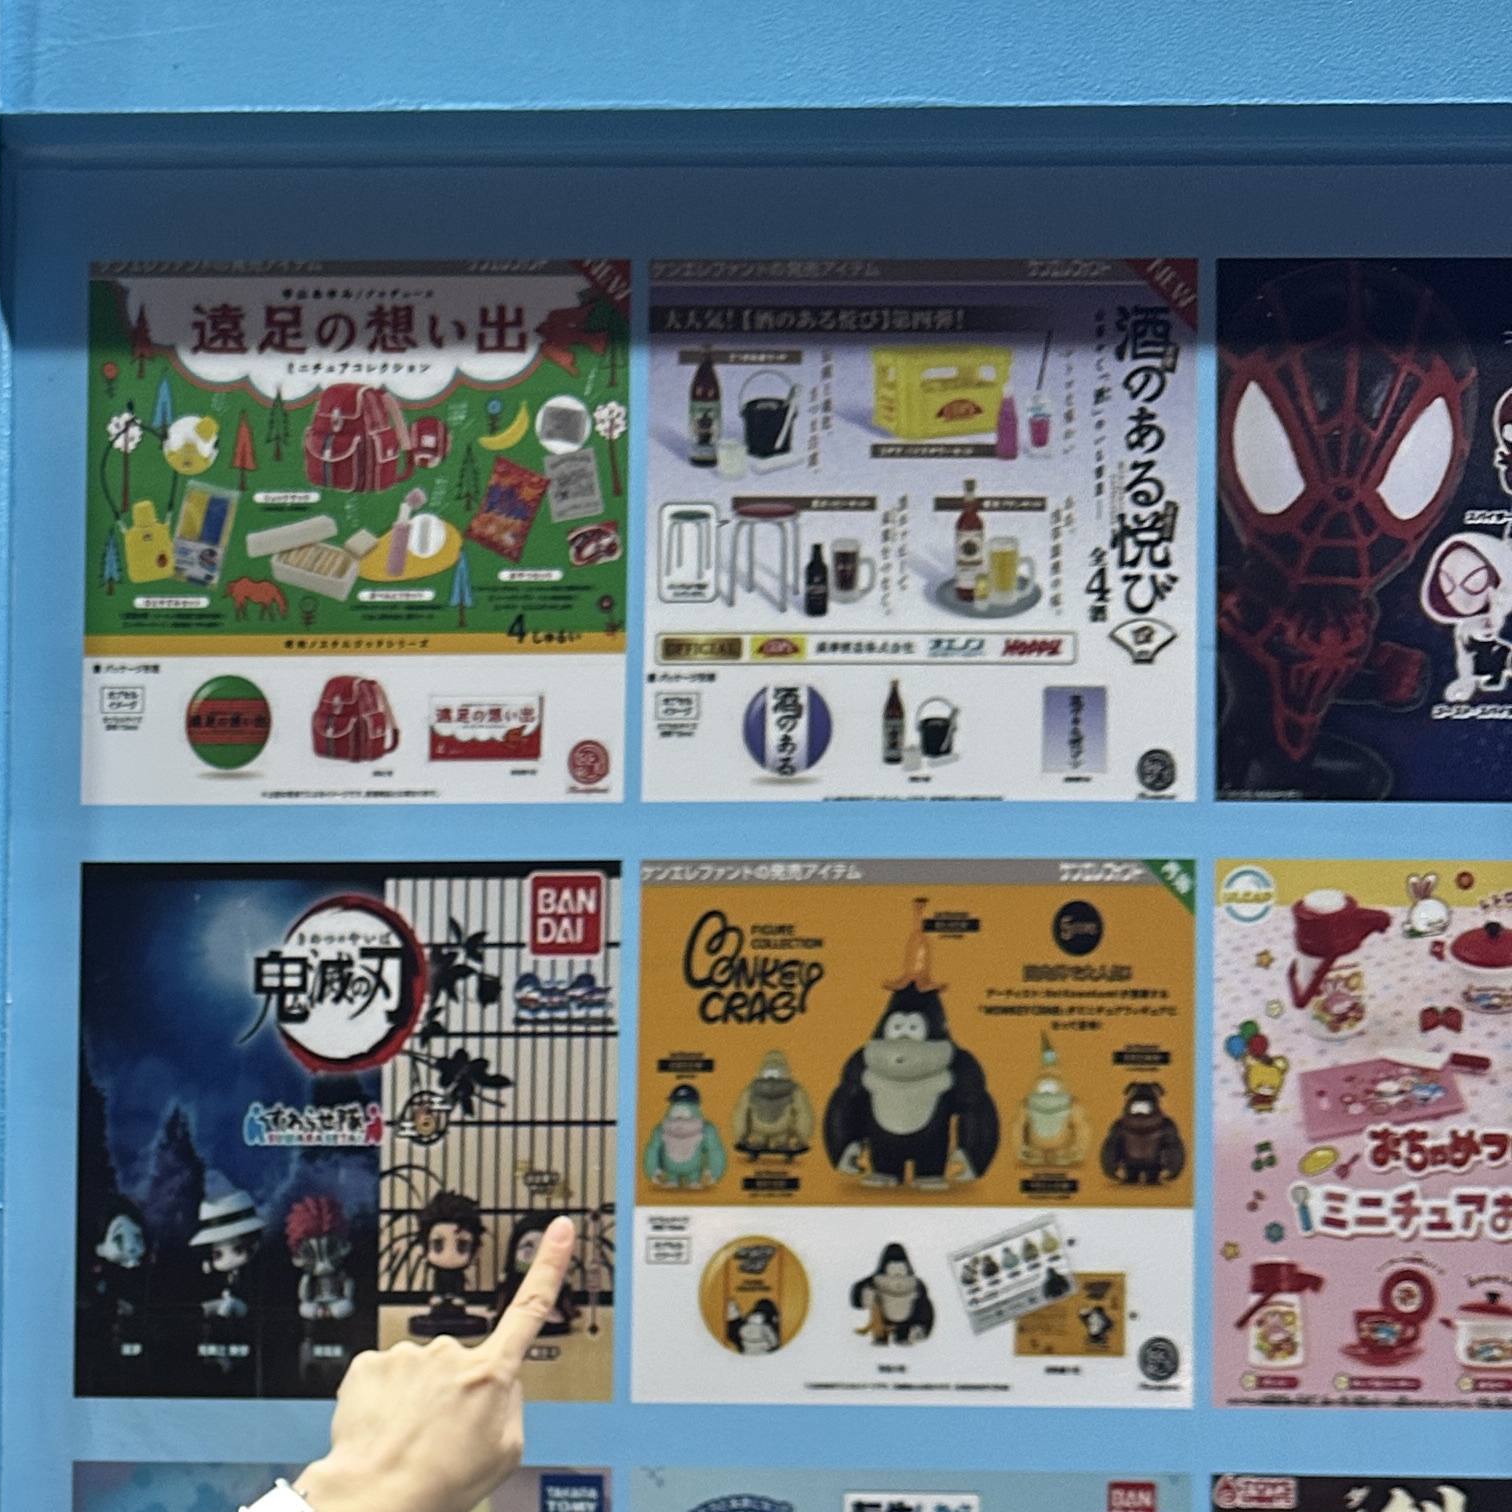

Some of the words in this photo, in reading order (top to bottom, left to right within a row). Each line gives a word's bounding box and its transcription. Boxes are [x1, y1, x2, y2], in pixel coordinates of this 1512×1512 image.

[191, 303, 528, 355] 遠足の想い出
[287, 361, 432, 375] ミニチュアコレクション
[1110, 304, 1180, 616] 酒のある悦び
[537, 888, 597, 914] BAN
[537, 917, 584, 943] DAI
[239, 949, 406, 1045] 鬼滅の刃
[546, 1501, 597, 1512] TOMY
